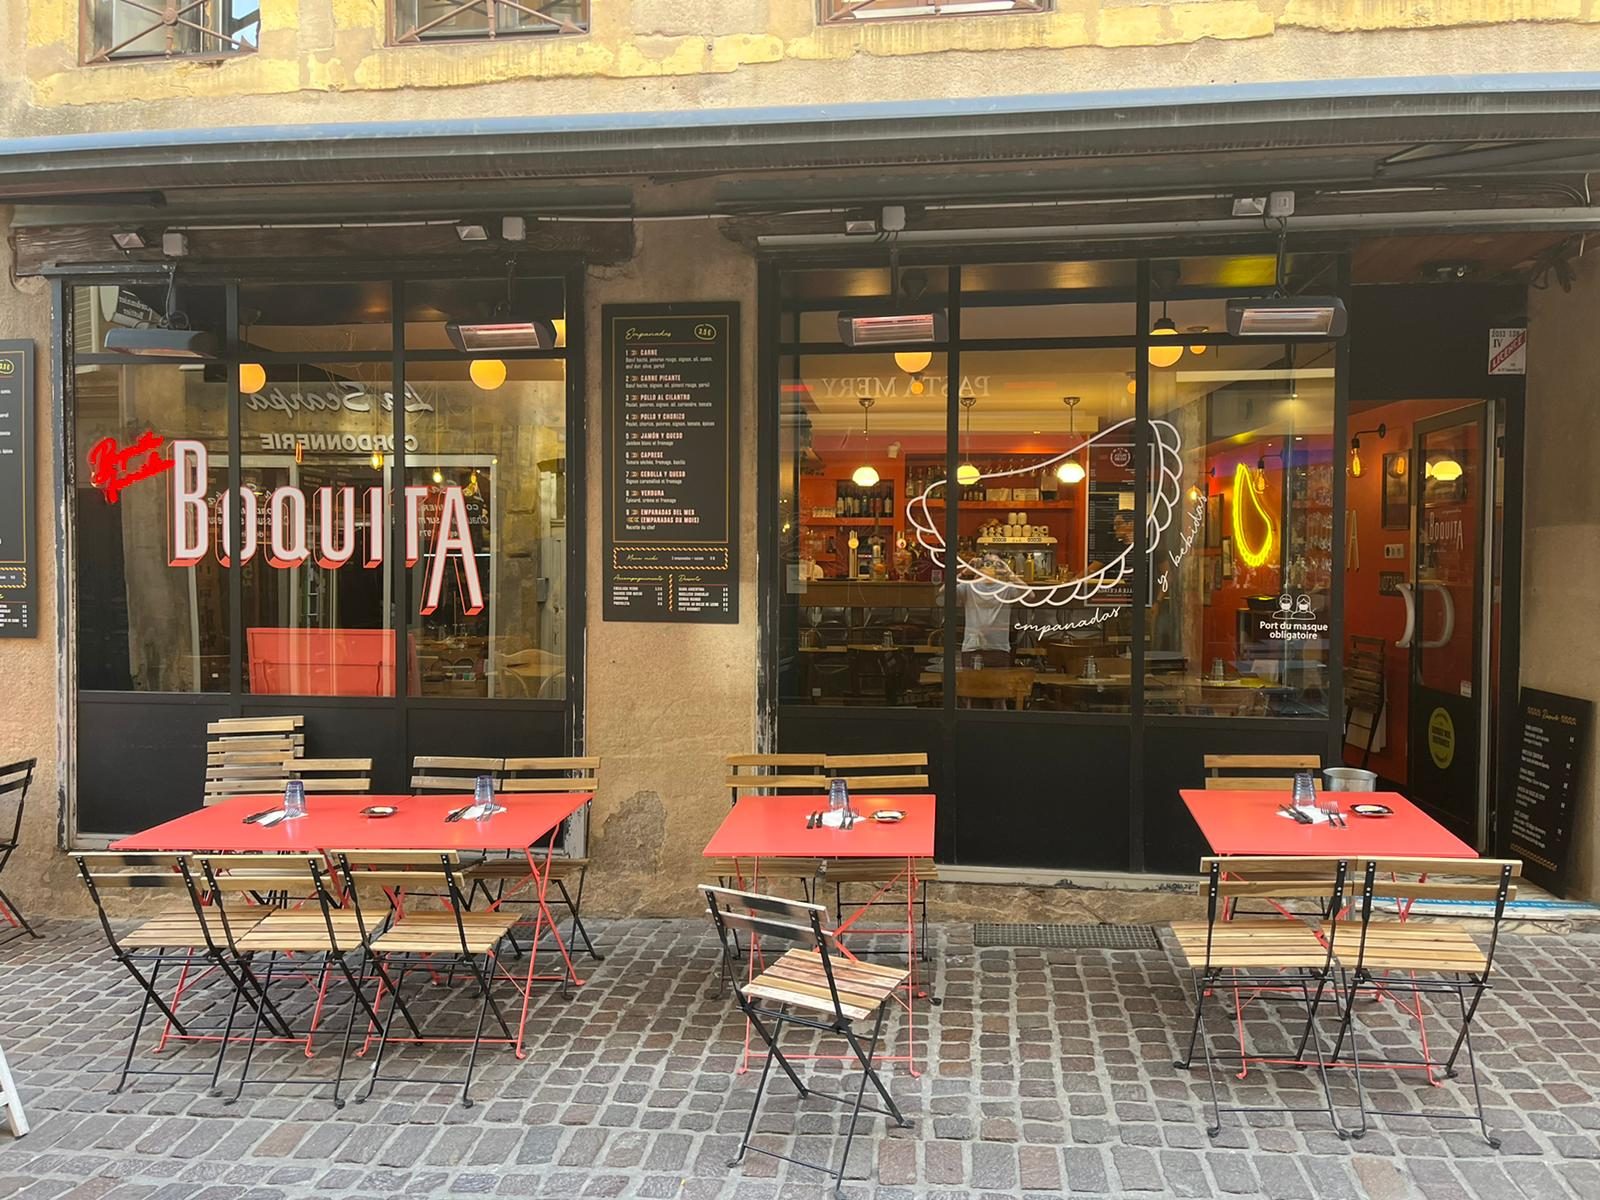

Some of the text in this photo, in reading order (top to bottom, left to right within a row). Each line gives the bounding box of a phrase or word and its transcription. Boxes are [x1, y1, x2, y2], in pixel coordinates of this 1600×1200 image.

[167, 440, 484, 616] BOQUITA
[1158, 495, 1208, 592] y bebidas
[1430, 512, 1464, 550] BOQUITA
[1014, 606, 1120, 640] empanadas
[1260, 620, 1328, 632] Port du masque
[1269, 630, 1318, 640] obligatoire
